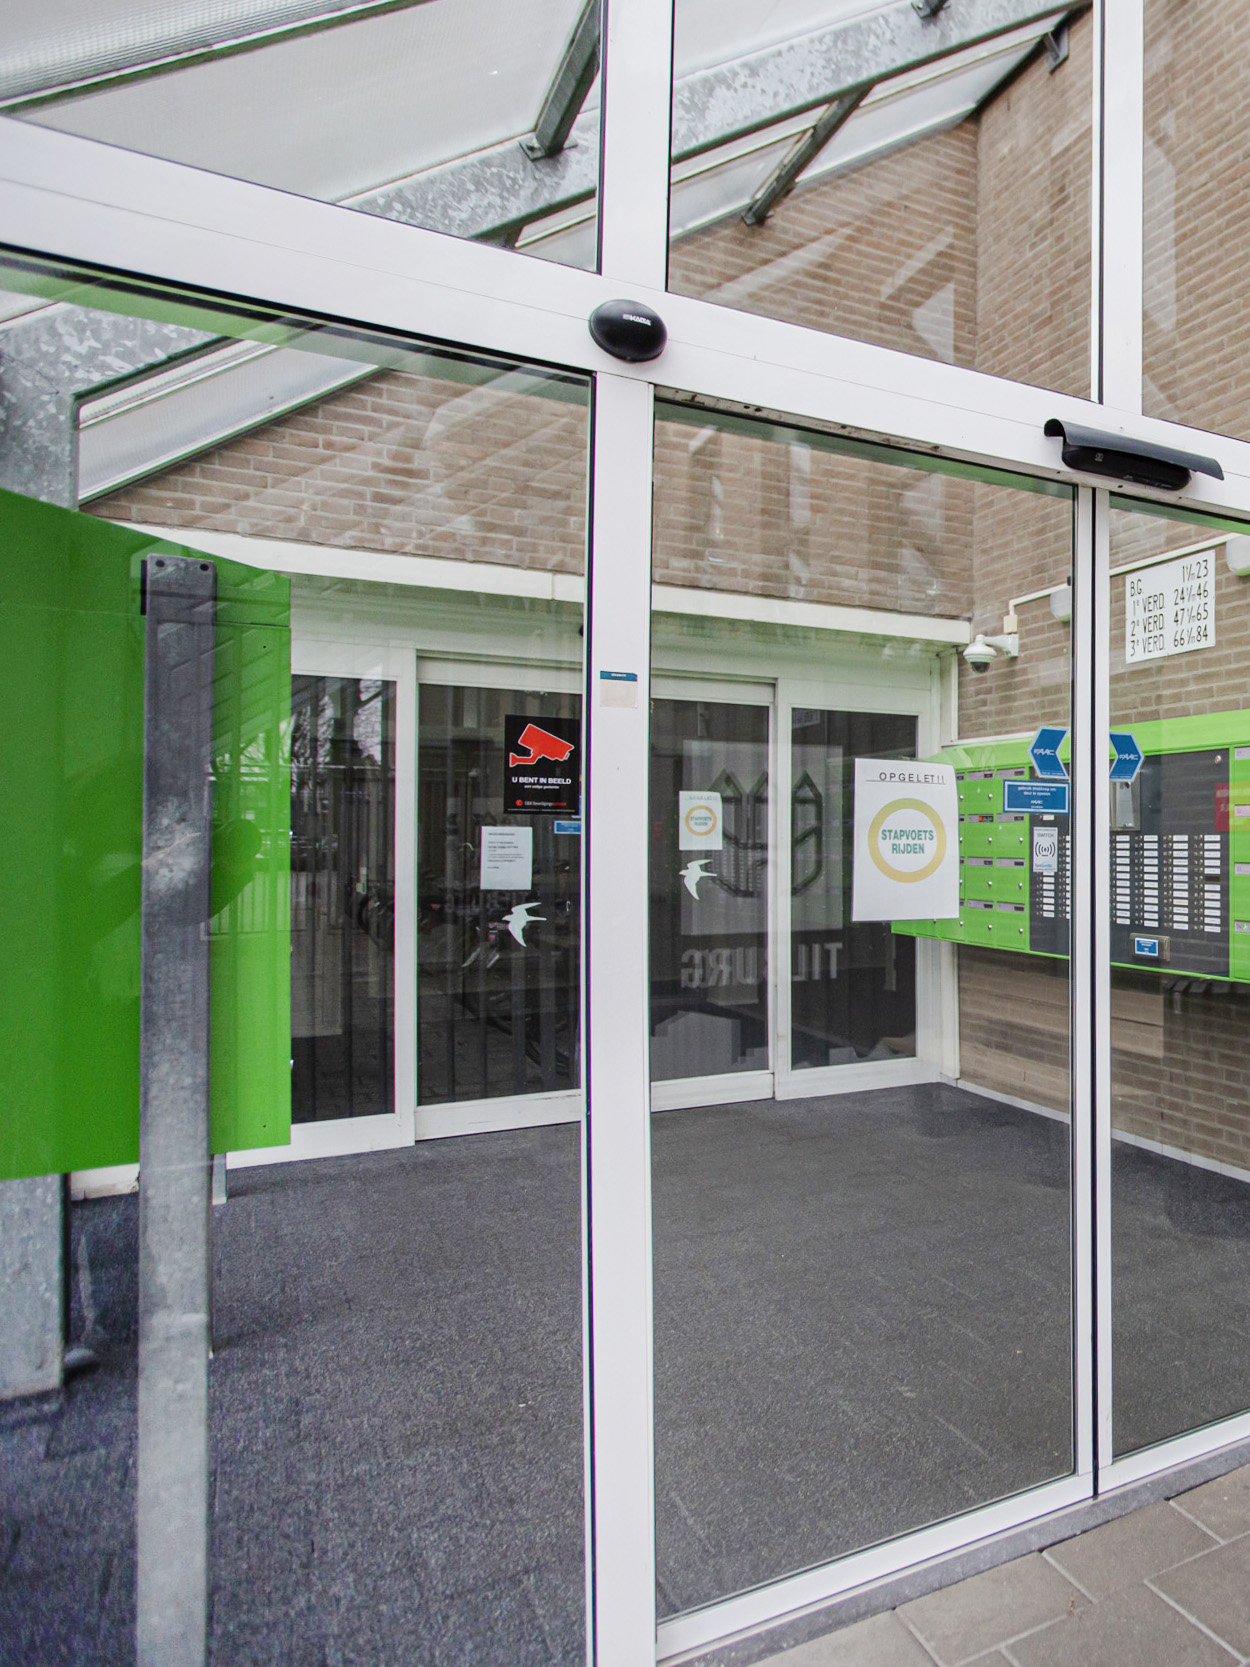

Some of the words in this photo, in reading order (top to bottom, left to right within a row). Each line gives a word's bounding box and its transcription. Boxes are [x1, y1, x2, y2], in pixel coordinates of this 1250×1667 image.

[518, 776, 538, 784] BENT
[881, 829, 934, 841] STAPVOETS
[891, 843, 925, 855] RIJDEN
